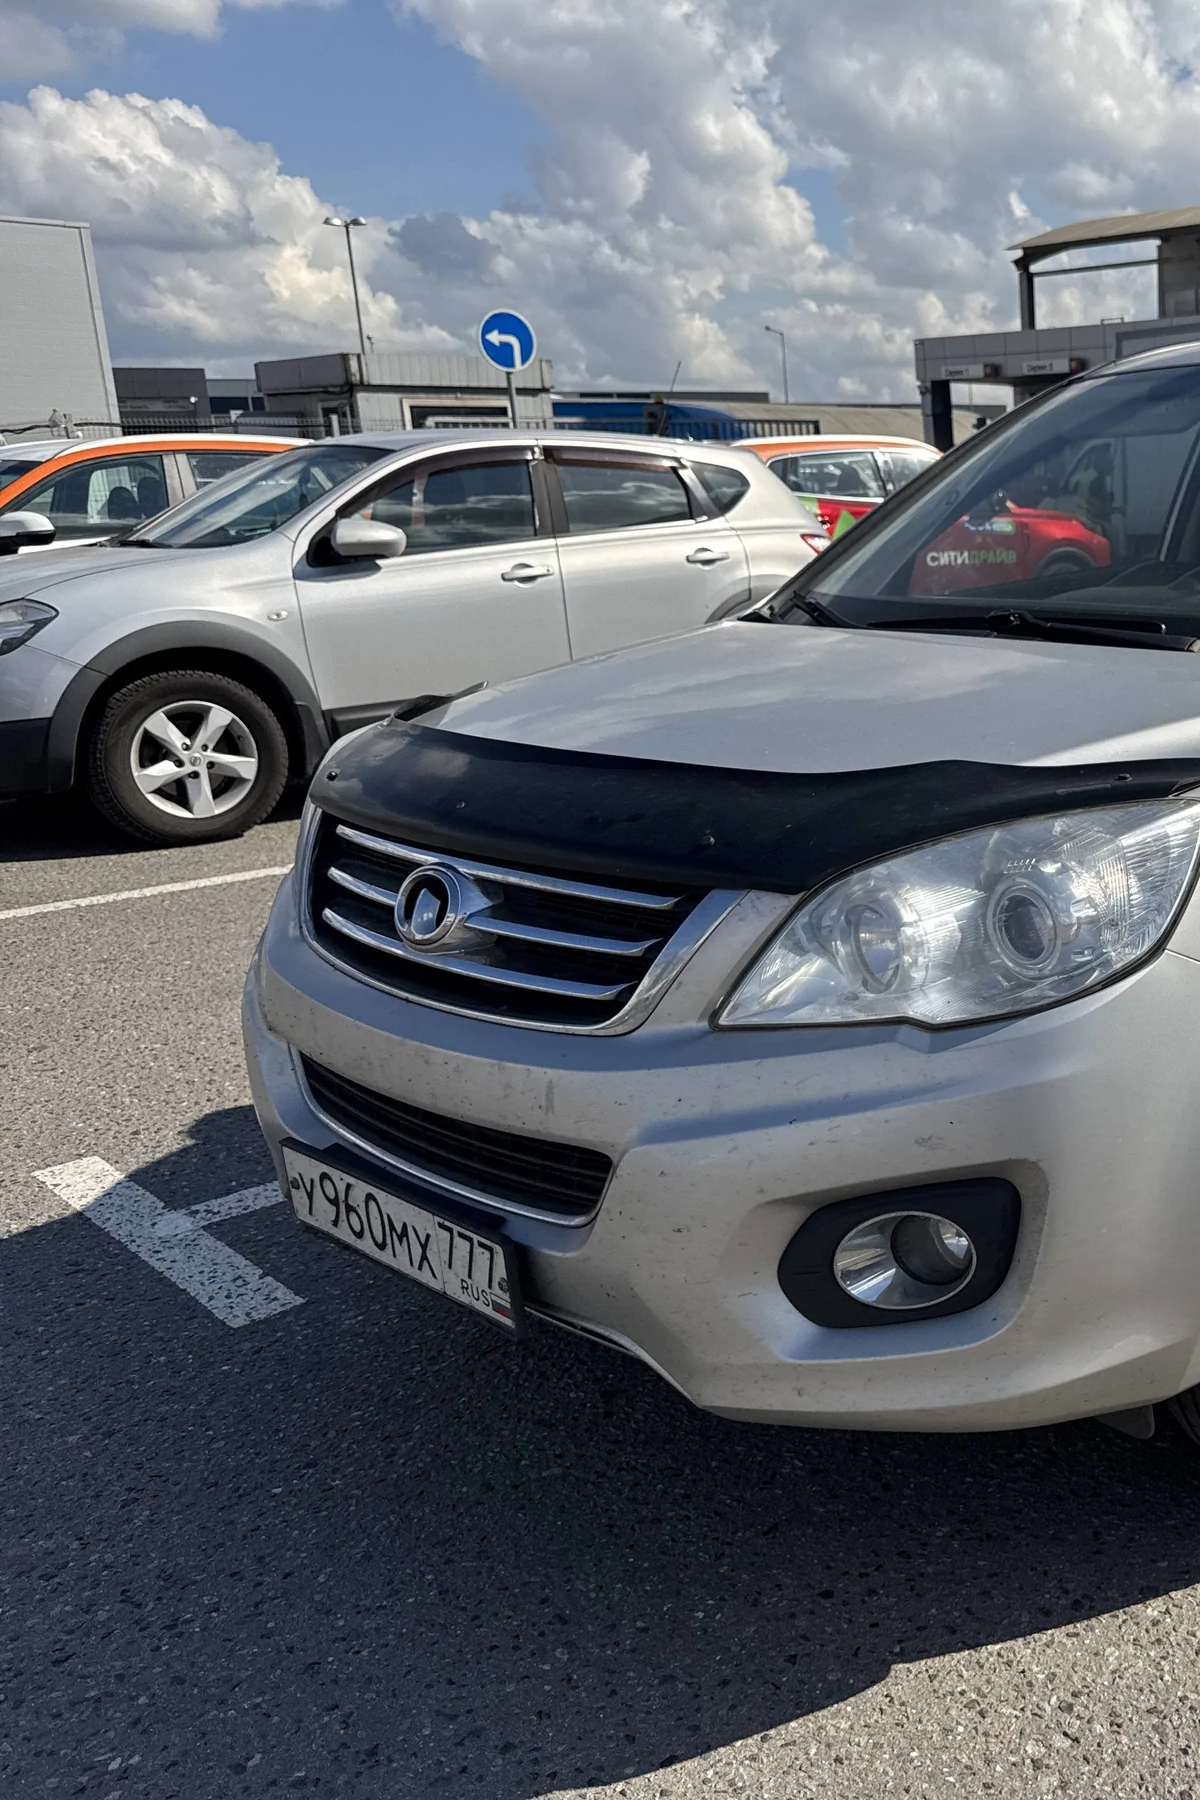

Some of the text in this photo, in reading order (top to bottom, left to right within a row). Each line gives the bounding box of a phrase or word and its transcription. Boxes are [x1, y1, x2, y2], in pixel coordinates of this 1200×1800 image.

[298, 1171, 495, 1290] У960МХ 777
[460, 1278, 490, 1307] RUS
